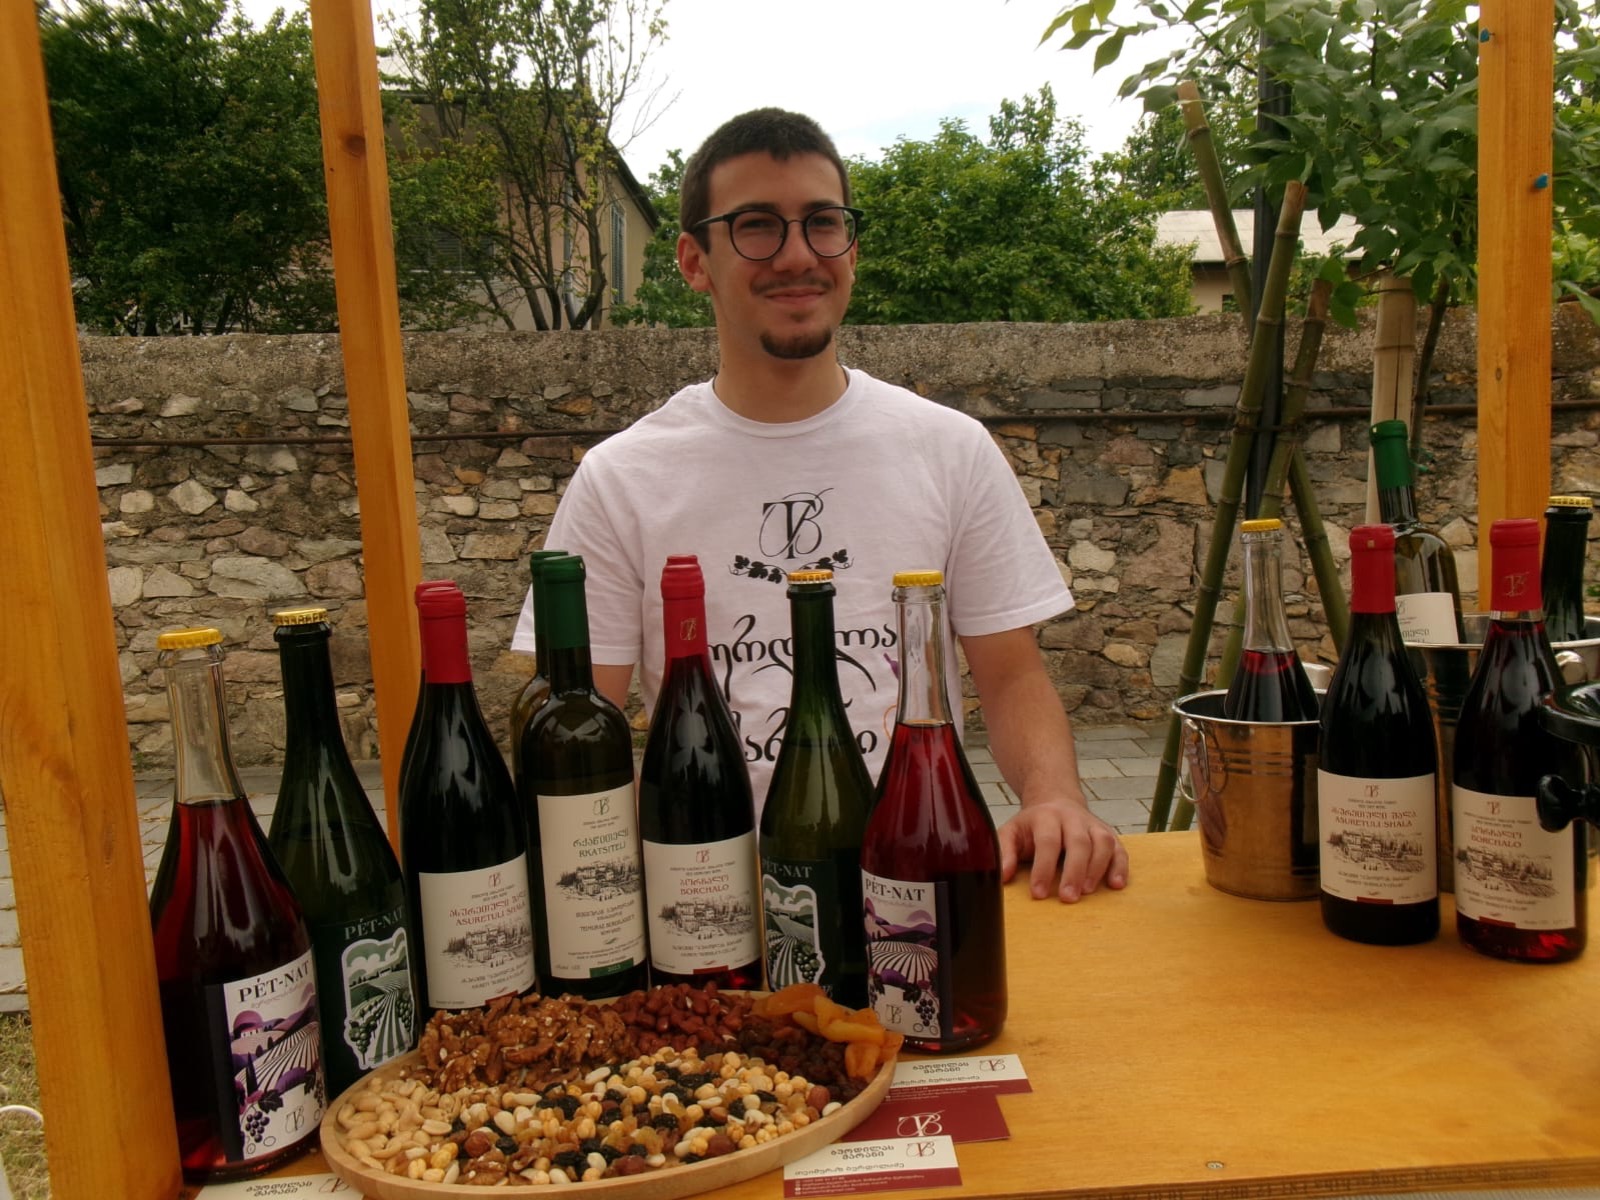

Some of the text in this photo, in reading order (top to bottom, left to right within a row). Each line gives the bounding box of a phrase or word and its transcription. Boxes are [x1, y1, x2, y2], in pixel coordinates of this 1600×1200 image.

[1471, 833, 1522, 848] BORCHALO
[578, 840, 627, 859] RKATSITELI
[680, 884, 730, 896] BORCHALO
[343, 905, 405, 940] PÉT-NAT
[456, 910, 505, 926] ASURETULI
[239, 960, 310, 1004] PÉT-NAT
